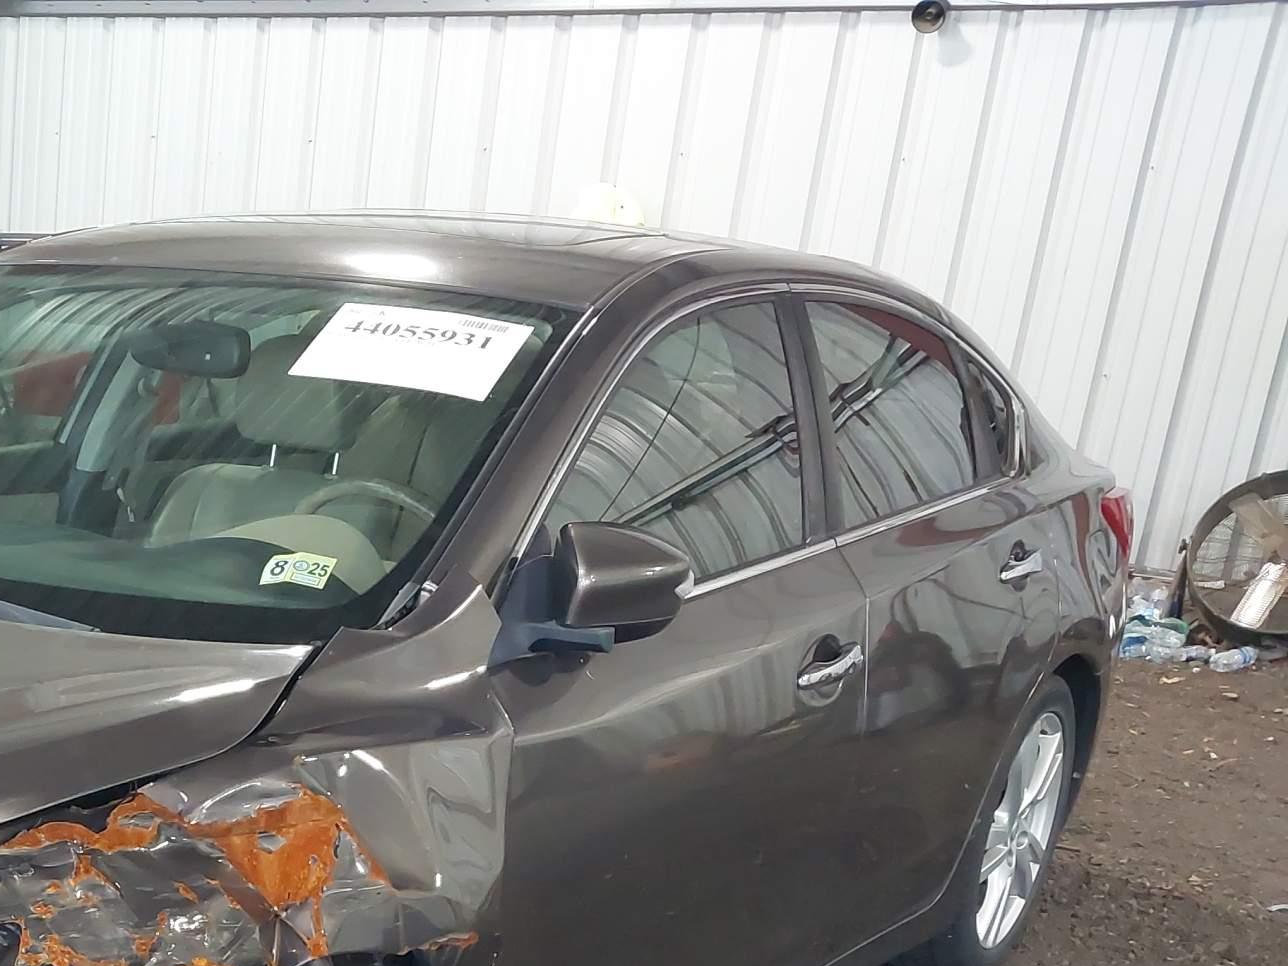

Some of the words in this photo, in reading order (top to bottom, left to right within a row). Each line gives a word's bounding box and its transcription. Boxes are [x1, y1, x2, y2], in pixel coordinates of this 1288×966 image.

[344, 320, 492, 349] 44055931
[269, 560, 289, 576] 8
[307, 562, 330, 577] 25
